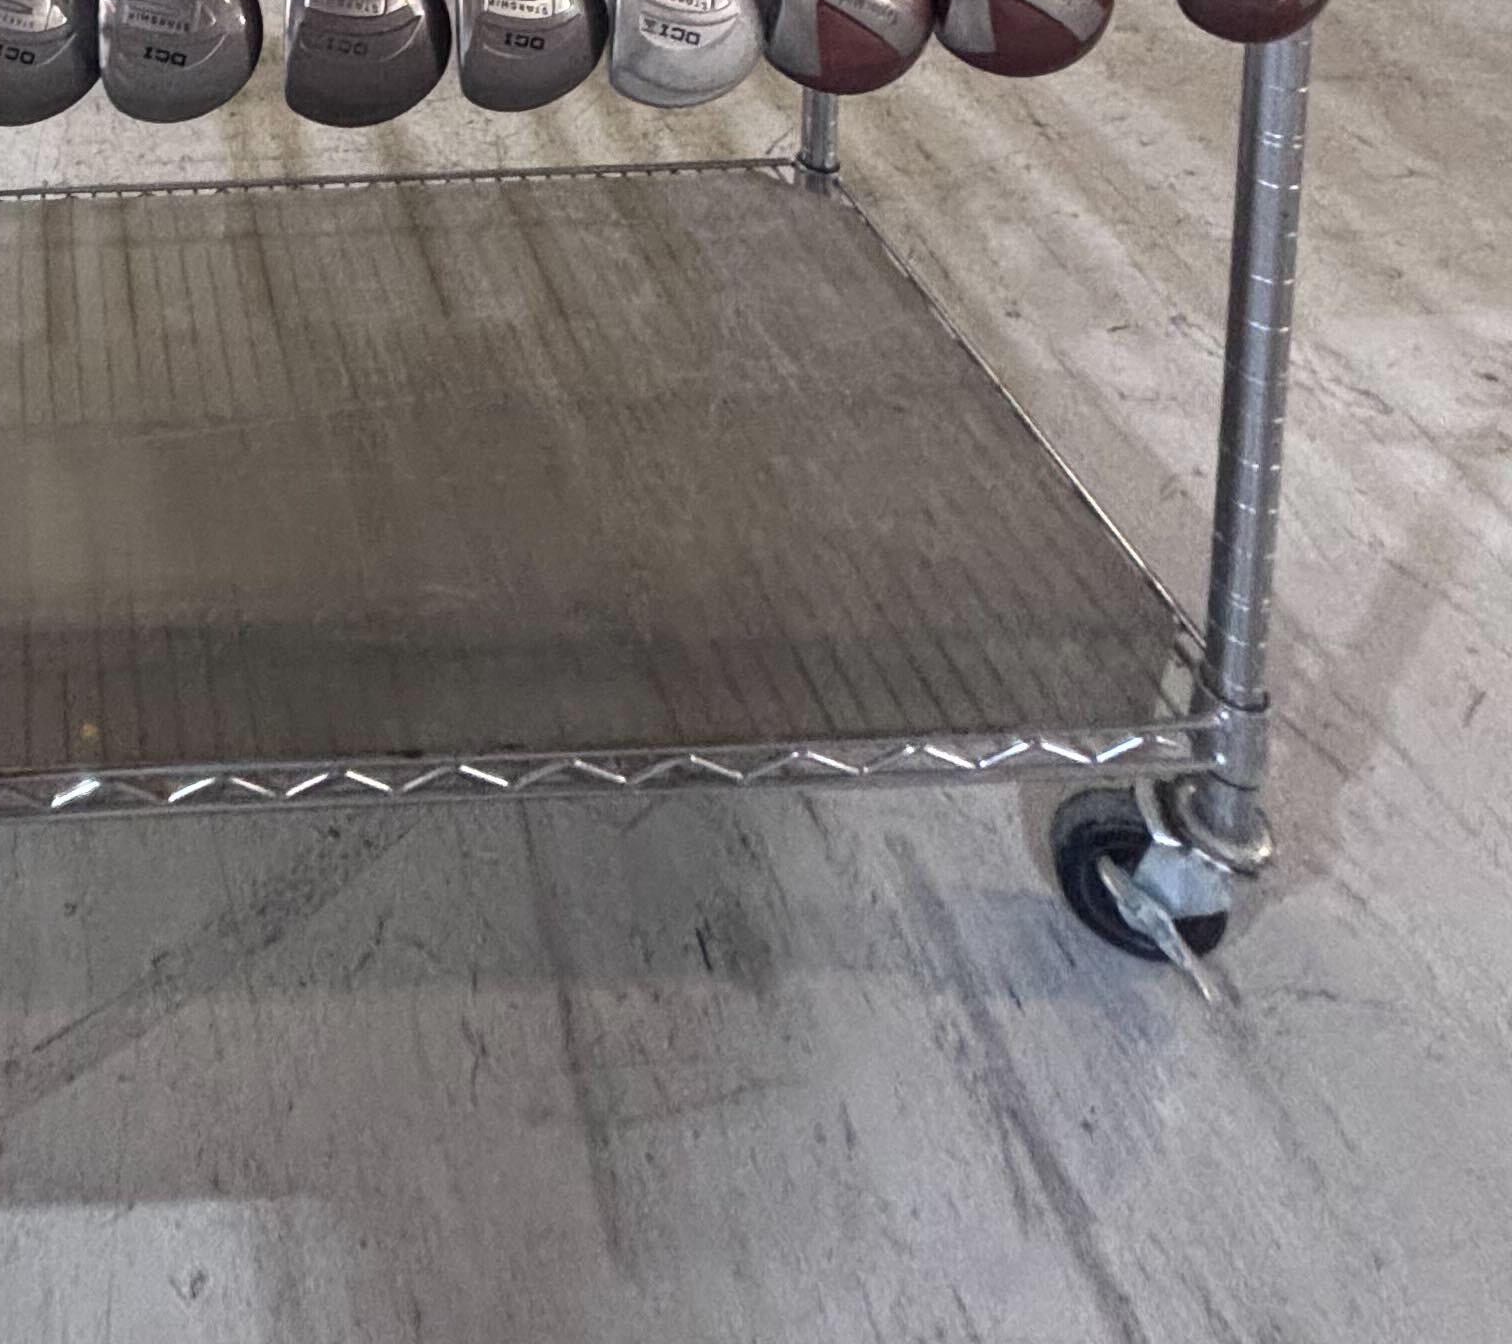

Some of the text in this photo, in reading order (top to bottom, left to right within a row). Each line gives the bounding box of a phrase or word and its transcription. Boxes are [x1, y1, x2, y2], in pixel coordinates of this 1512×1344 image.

[503, 33, 545, 50] DCI
[660, 25, 701, 45] DCI
[143, 46, 187, 67] DCI
[326, 38, 369, 56] DCI
